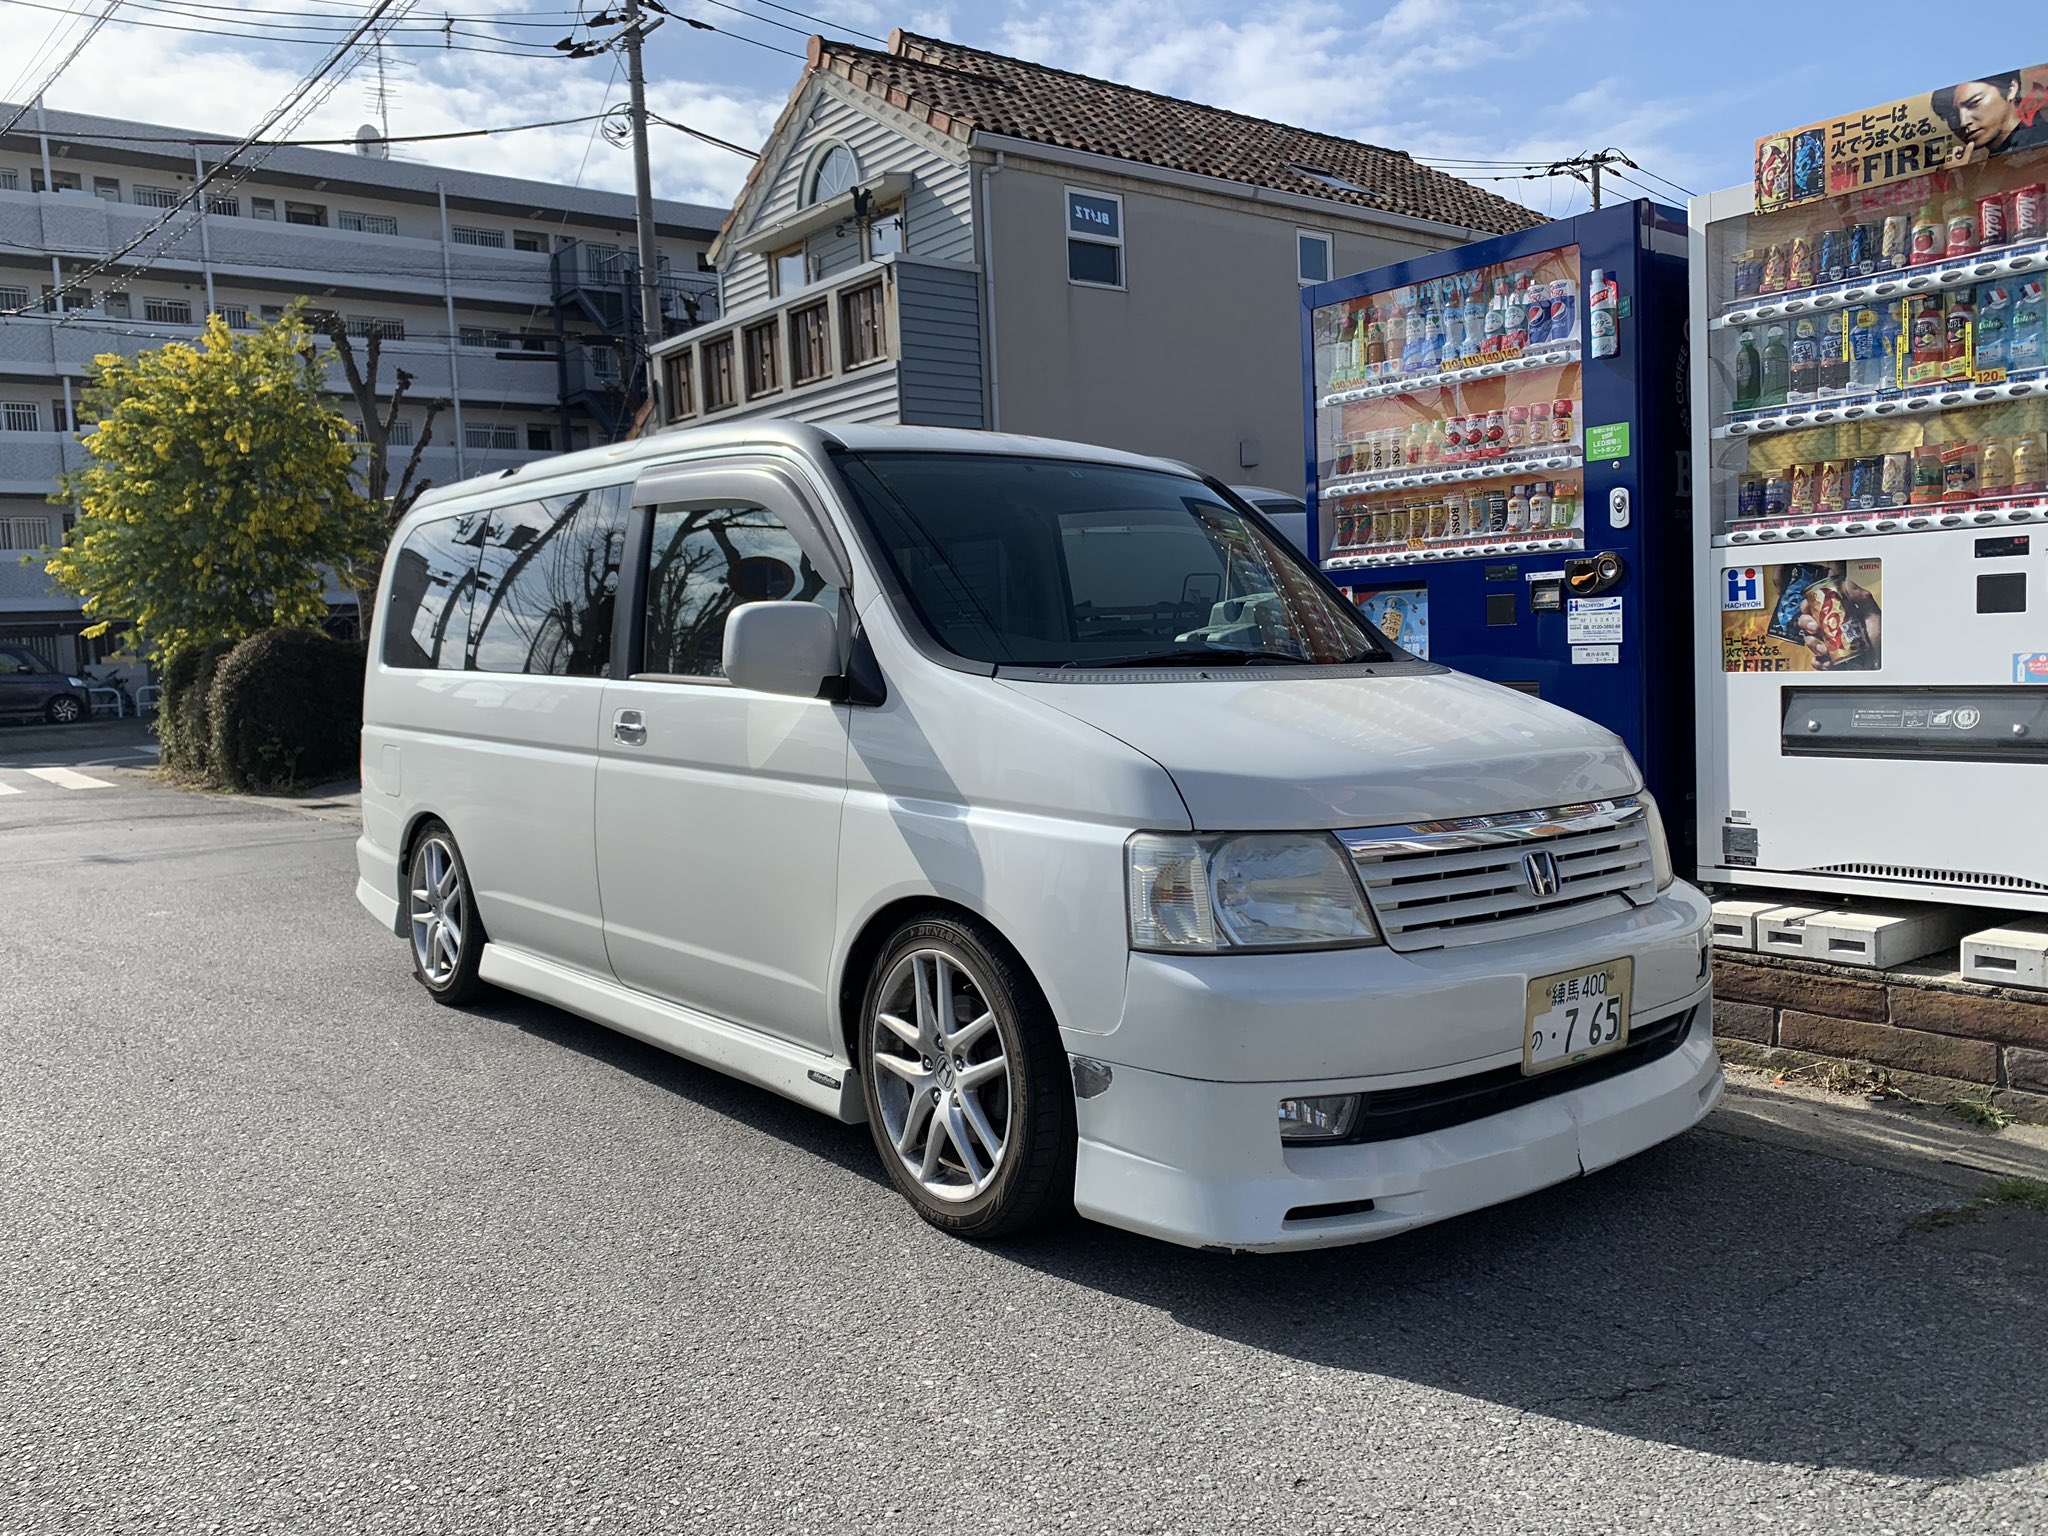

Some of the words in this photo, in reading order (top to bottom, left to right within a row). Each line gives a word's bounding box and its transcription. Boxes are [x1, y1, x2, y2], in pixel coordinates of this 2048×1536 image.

[1832, 104, 1908, 138] コーヒーは
[1831, 118, 1937, 158] 火でうまくなる。
[1863, 136, 1946, 184] FIRE
[1984, 203, 2002, 239] Mets
[2018, 196, 2036, 230] Mets
[1482, 352, 1499, 362] 140
[1502, 348, 1519, 359] 140
[1374, 442, 1382, 468] BOSS
[1391, 439, 1400, 465] BOSS
[1451, 507, 1460, 534] BOSS
[1492, 501, 1503, 532] BLACK
[1858, 563, 1880, 571] KIRIN
[1724, 600, 1762, 609] HACHIYOH
[1725, 635, 1766, 646] コーヒーは
[1726, 646, 1782, 657] 火でうまくなる。
[918, 926, 961, 944] DUNLOP
[1552, 978, 1580, 1006] 練馬
[1582, 972, 1606, 998] 400
[812, 1072, 836, 1084] Modulo
